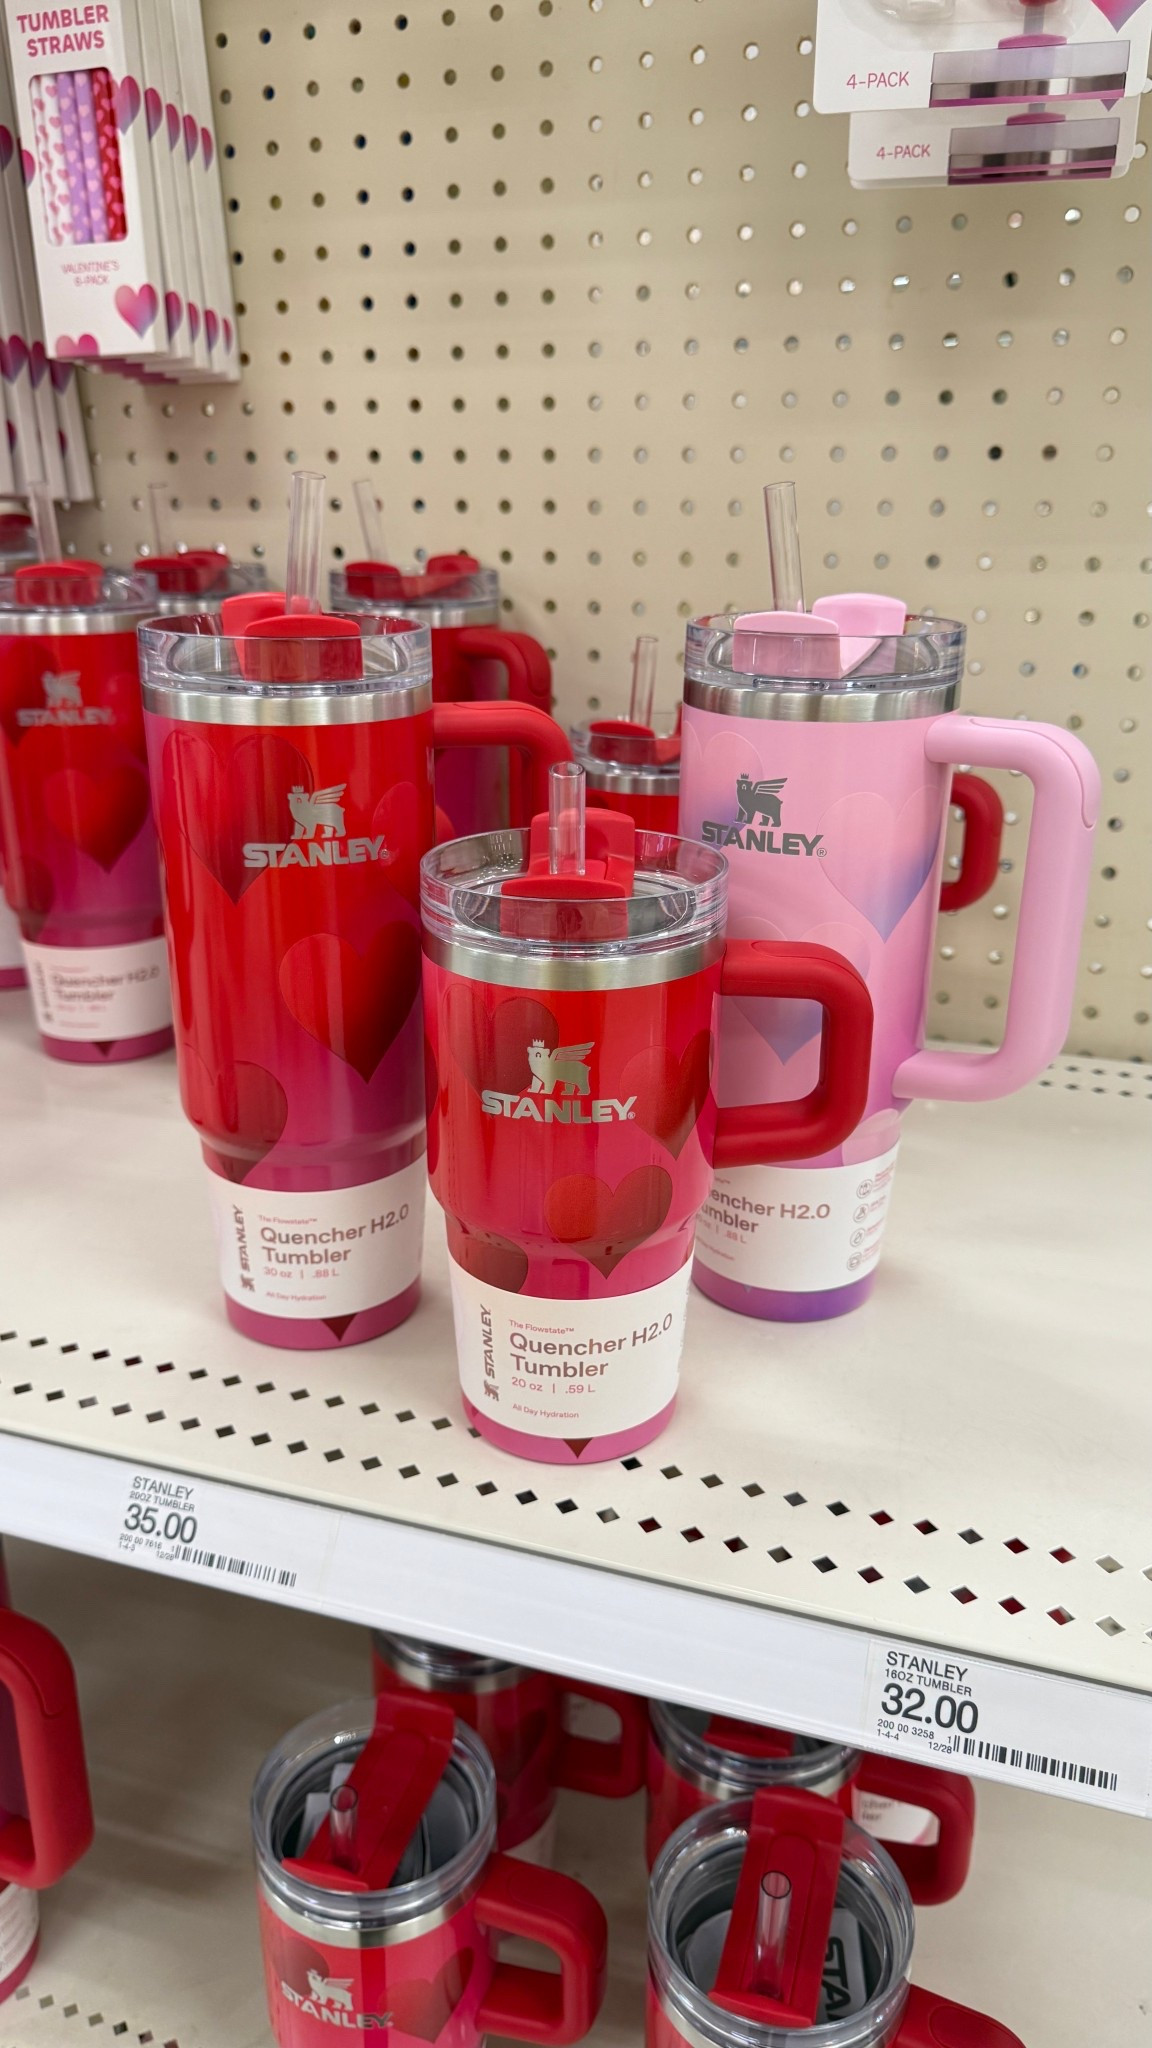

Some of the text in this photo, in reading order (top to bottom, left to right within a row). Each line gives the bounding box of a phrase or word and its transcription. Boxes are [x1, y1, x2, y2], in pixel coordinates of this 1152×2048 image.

[17, 4, 110, 34] TUMBLER
[26, 30, 106, 58] STRAWS
[846, 71, 910, 90] 4-PACK
[876, 144, 931, 160] 4-PACK
[701, 1203, 759, 1233] umbler
[708, 1188, 830, 1220] encher H2.0
[260, 1203, 410, 1245] Quencher H2.0
[233, 1204, 251, 1273] STANLEY
[261, 1246, 352, 1265] Tumbler
[508, 1319, 524, 1330] The
[509, 1312, 673, 1356] Quencher H2.0
[480, 1304, 496, 1379] STANLEY
[509, 1352, 609, 1378] Tumbler
[511, 1376, 526, 1388] 20
[529, 1382, 543, 1392] oz
[565, 1384, 584, 1394] .59
[588, 1384, 595, 1393] L
[512, 1403, 579, 1419] All Day Hydration
[132, 1476, 194, 1500] STANLEY
[153, 1494, 195, 1512] TUMBLER
[124, 1503, 198, 1543] 35.00
[886, 1650, 969, 1683] STANLEY
[884, 1668, 973, 1698] 16OZ TUMBLER
[881, 1682, 978, 1733] 32.00
[876, 1728, 952, 1755] 1-4-4 12/28
[877, 1718, 895, 1730] 200
[897, 1722, 909, 1734] 00
[911, 1726, 935, 1740] 3258
